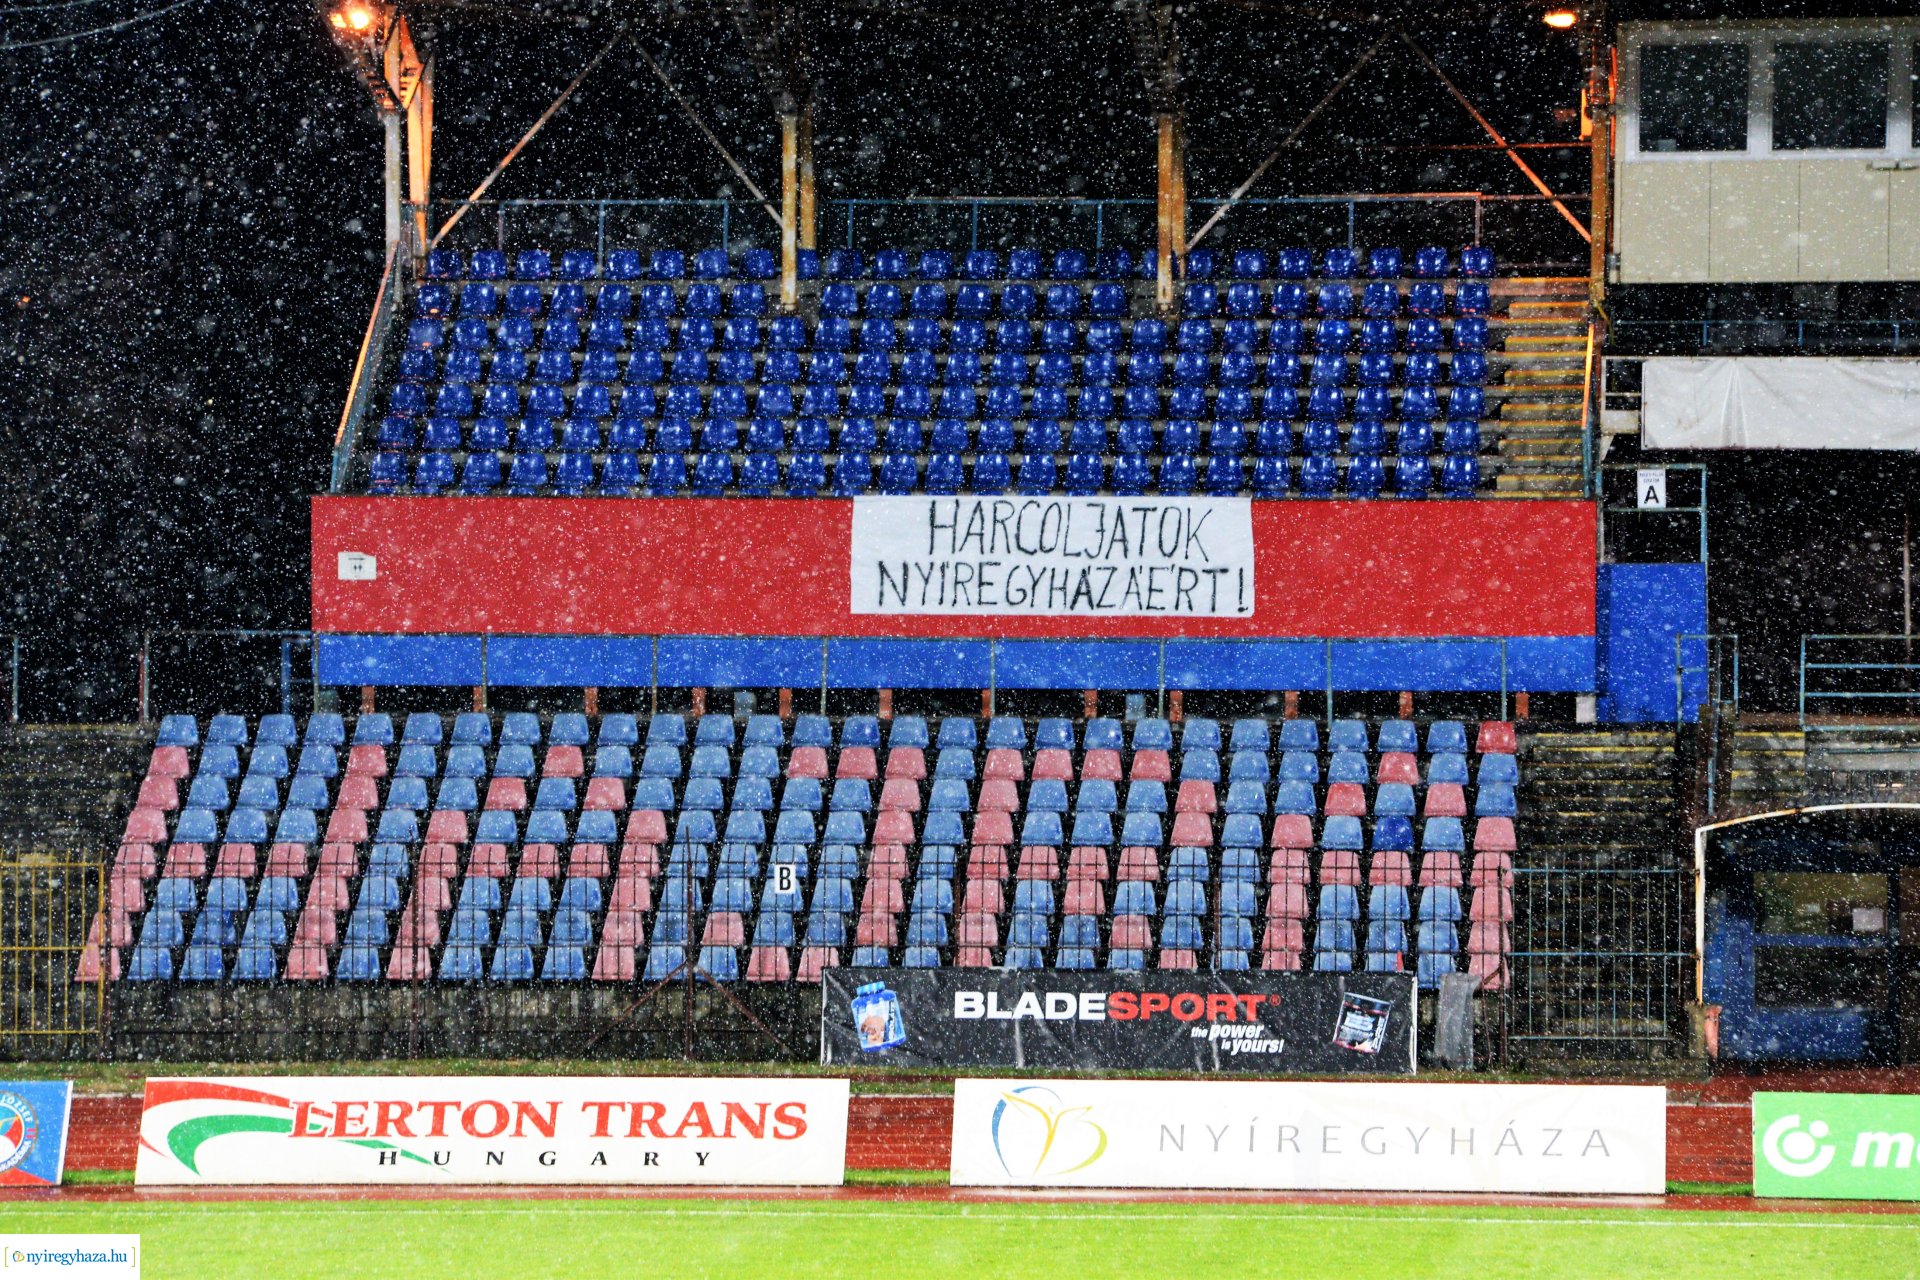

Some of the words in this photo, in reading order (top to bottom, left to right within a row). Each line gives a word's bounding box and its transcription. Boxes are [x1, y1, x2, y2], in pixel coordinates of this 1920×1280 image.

[1643, 485, 1660, 504] A
[928, 498, 1214, 562] HARCOLJATOK
[779, 866, 792, 891] B
[1190, 1026, 1209, 1038] the
[1208, 1024, 1264, 1041] power
[1221, 1039, 1232, 1050] is
[1230, 1039, 1285, 1056] yours!
[288, 1099, 564, 1138] LERTON
[580, 1100, 809, 1140] TRANS
[1158, 1116, 1612, 1158] NYÍREGYHÁZA
[378, 1150, 711, 1167] HUNGARY
